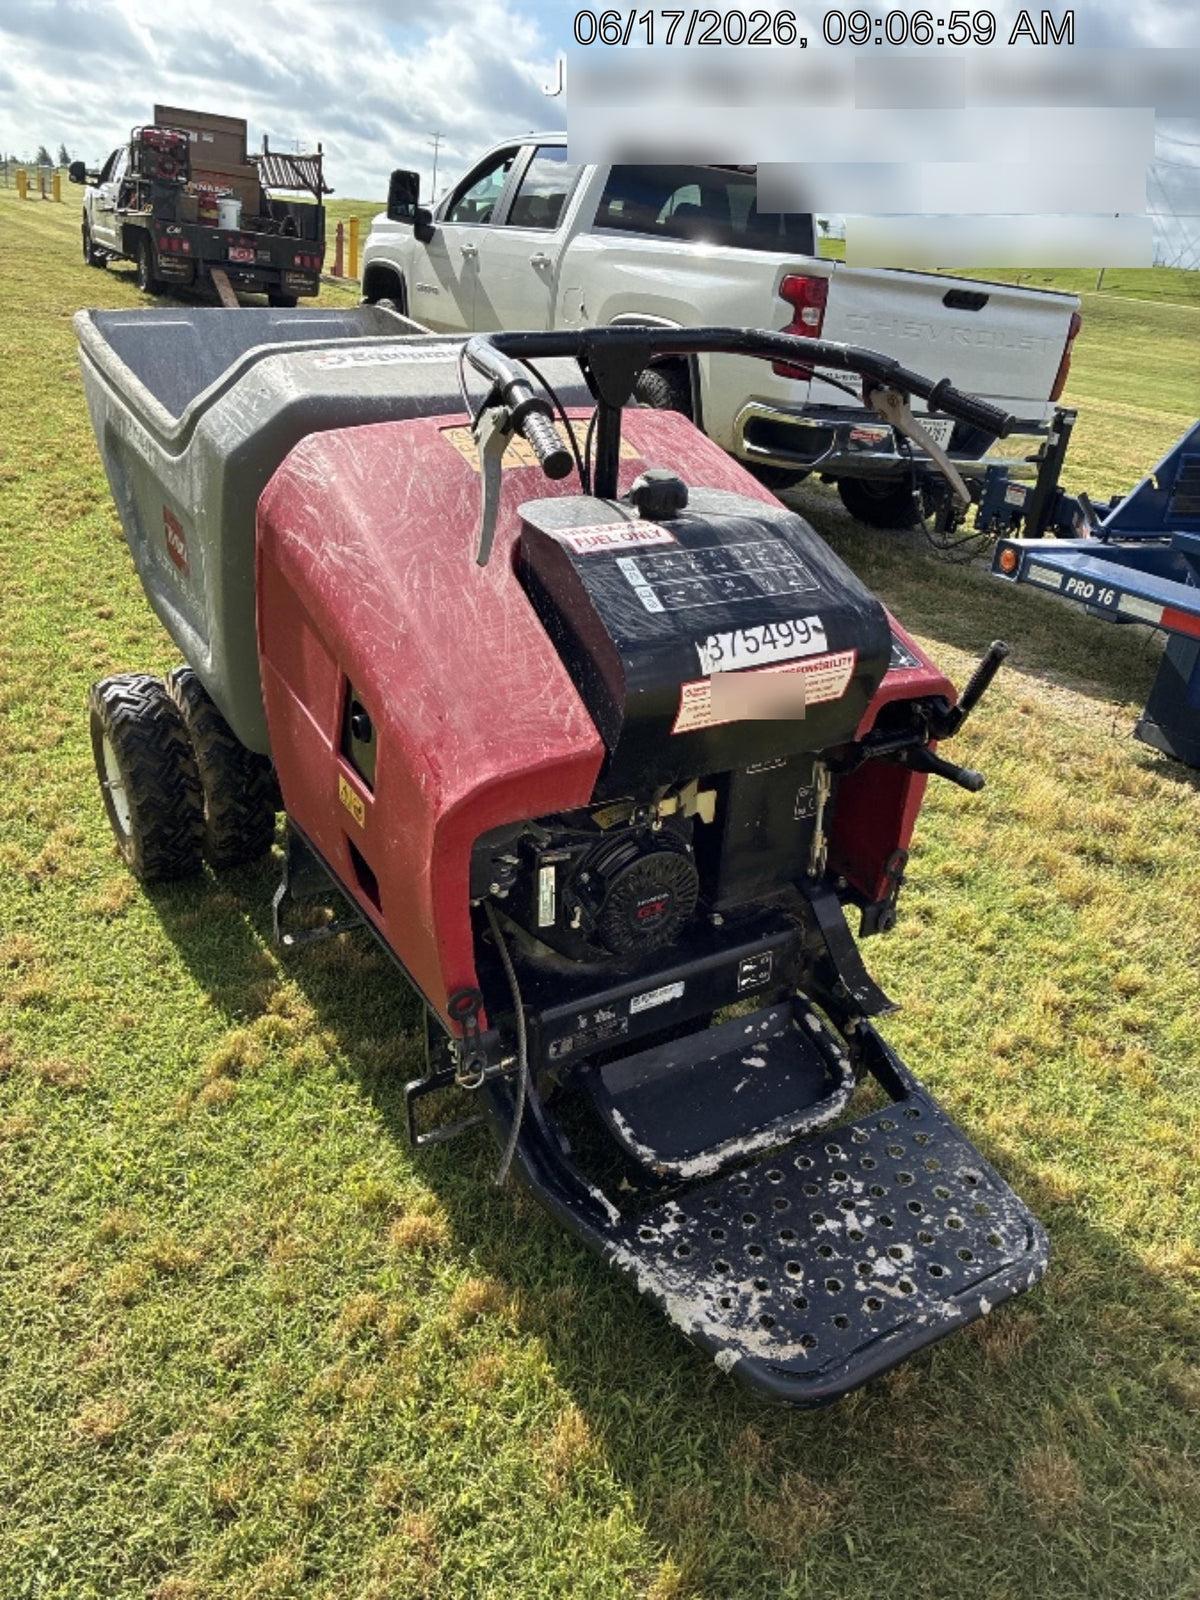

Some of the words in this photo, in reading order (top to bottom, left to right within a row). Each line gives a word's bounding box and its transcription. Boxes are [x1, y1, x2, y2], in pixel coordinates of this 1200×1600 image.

[844, 313, 1055, 350] CHEVROLET
[574, 533, 619, 547] FUEL
[620, 529, 662, 541] ONLY
[1065, 577, 1094, 599] PRO
[1097, 588, 1116, 606] 16
